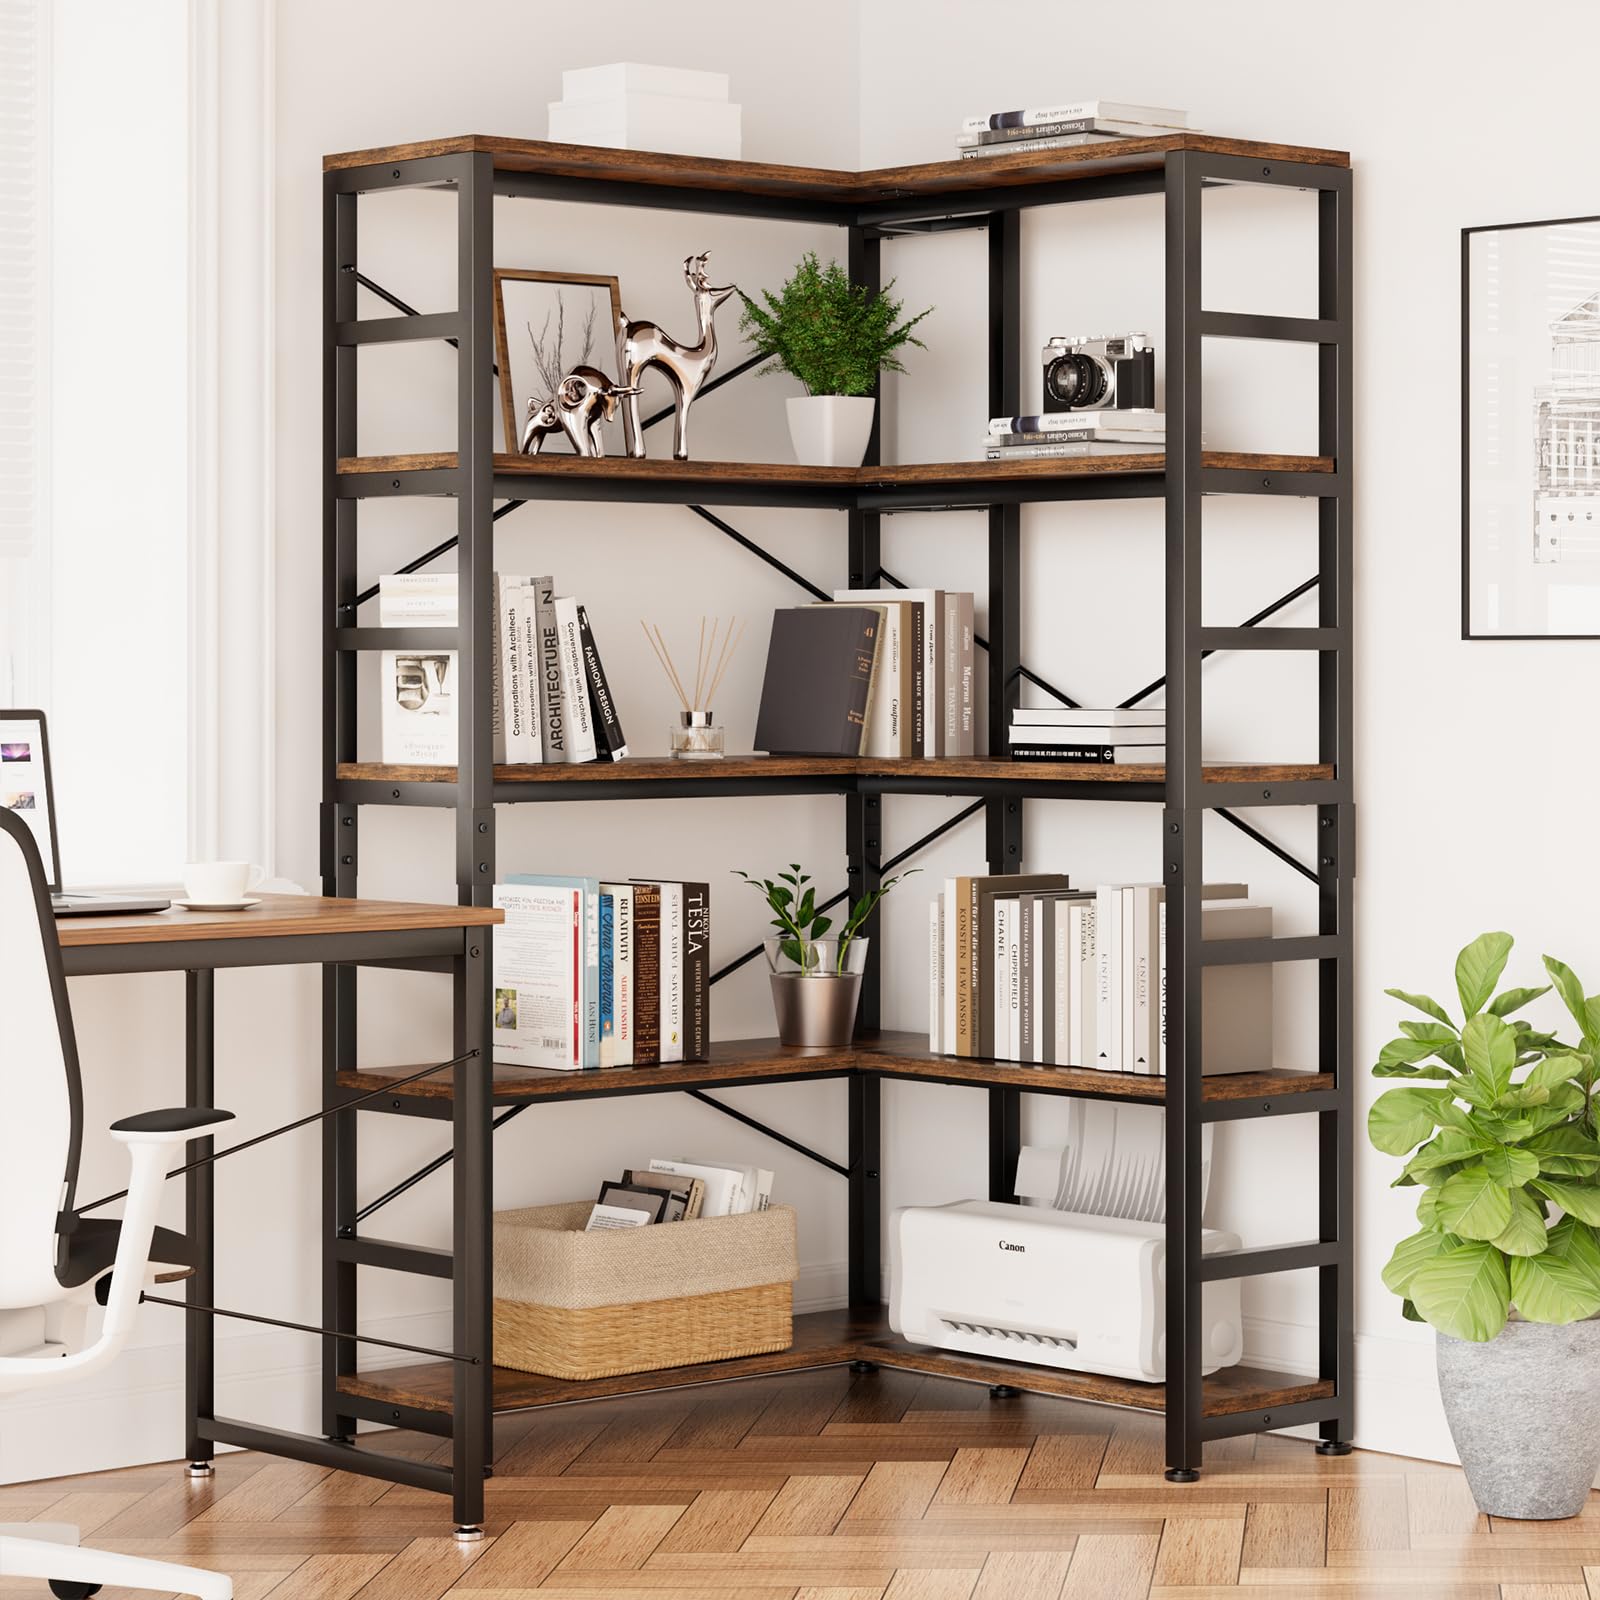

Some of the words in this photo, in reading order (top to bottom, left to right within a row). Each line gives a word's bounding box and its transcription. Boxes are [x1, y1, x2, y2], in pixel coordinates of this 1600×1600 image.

[1036, 125, 1060, 134] Guitars
[1061, 122, 1085, 131] Picasso
[1047, 433, 1067, 441] Guitars
[1068, 432, 1087, 440] Picasso
[508, 608, 517, 651] Architects
[510, 658, 518, 672] with
[567, 622, 579, 676] Conversations
[543, 627, 564, 751] ARCHITECTURE
[575, 677, 584, 693] with
[584, 646, 603, 688] FASHION
[598, 690, 614, 724] DESIGN
[962, 666, 971, 702] Мартин
[512, 674, 520, 736] Conversations
[529, 679, 537, 737] Conversations
[577, 695, 587, 733] Architects
[962, 707, 971, 731] Иден
[635, 894, 660, 903] EINSTEIN
[602, 914, 613, 950] Anna
[620, 898, 628, 962] RELATIVITY
[688, 893, 702, 954] TESLA
[602, 955, 613, 1016] Karenina
[999, 1240, 1025, 1252] Canon
